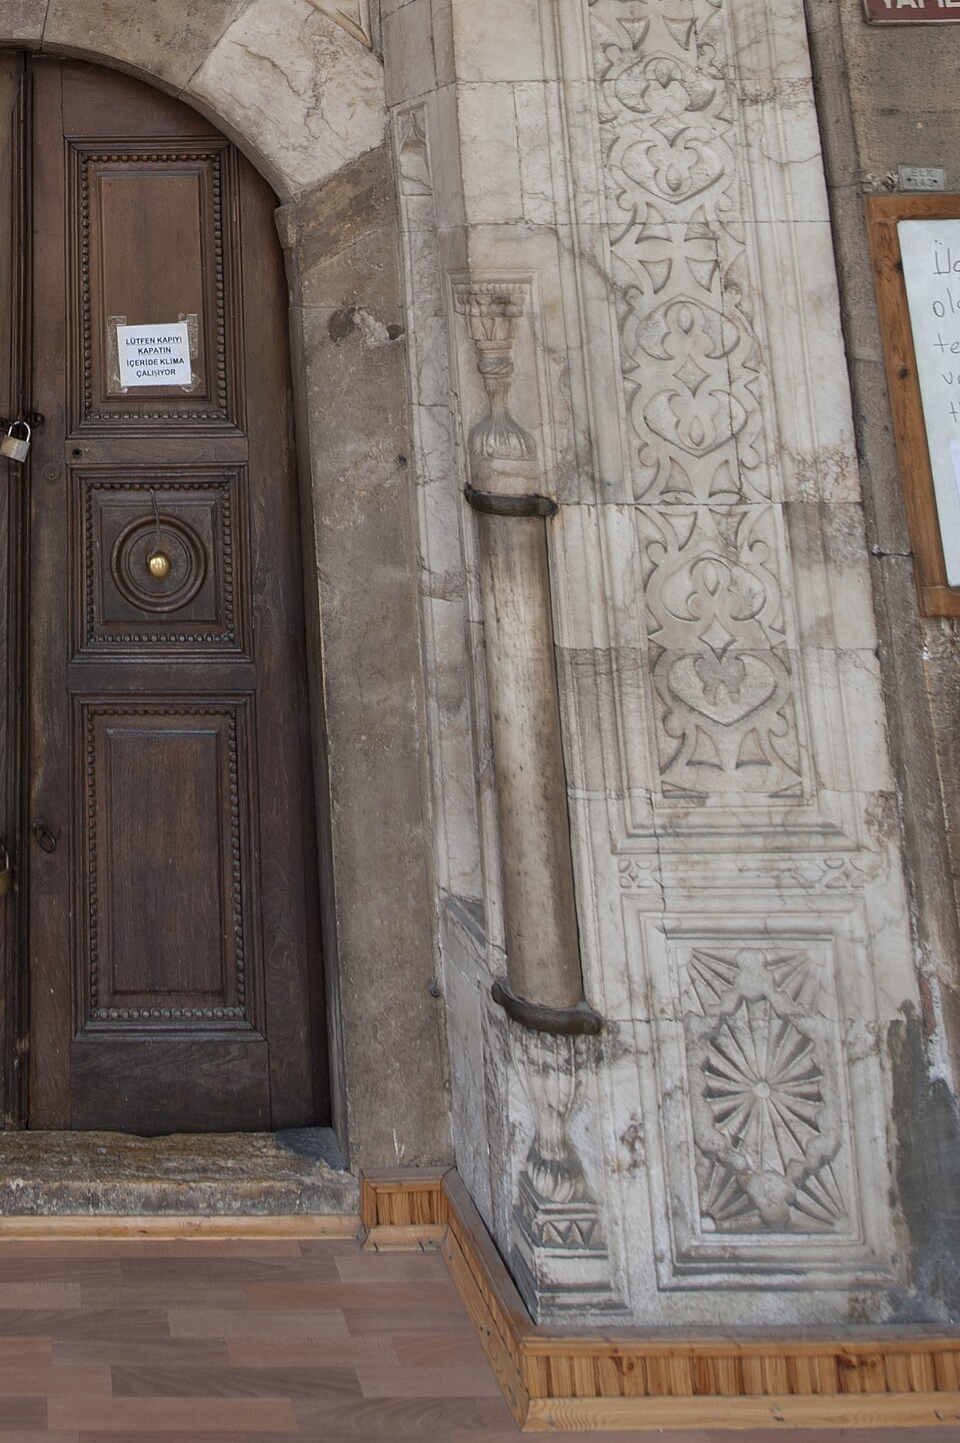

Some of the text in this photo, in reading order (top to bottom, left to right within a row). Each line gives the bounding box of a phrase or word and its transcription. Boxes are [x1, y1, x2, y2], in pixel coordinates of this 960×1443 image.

[933, 287, 960, 318] ol
[126, 336, 182, 346] LÜTFEN KAPIYI
[138, 346, 172, 355] KAPATIN
[126, 357, 184, 368] İÇERİDE KLİMA
[136, 368, 176, 378] ÇALIŞIYOR
[942, 371, 960, 385] v
